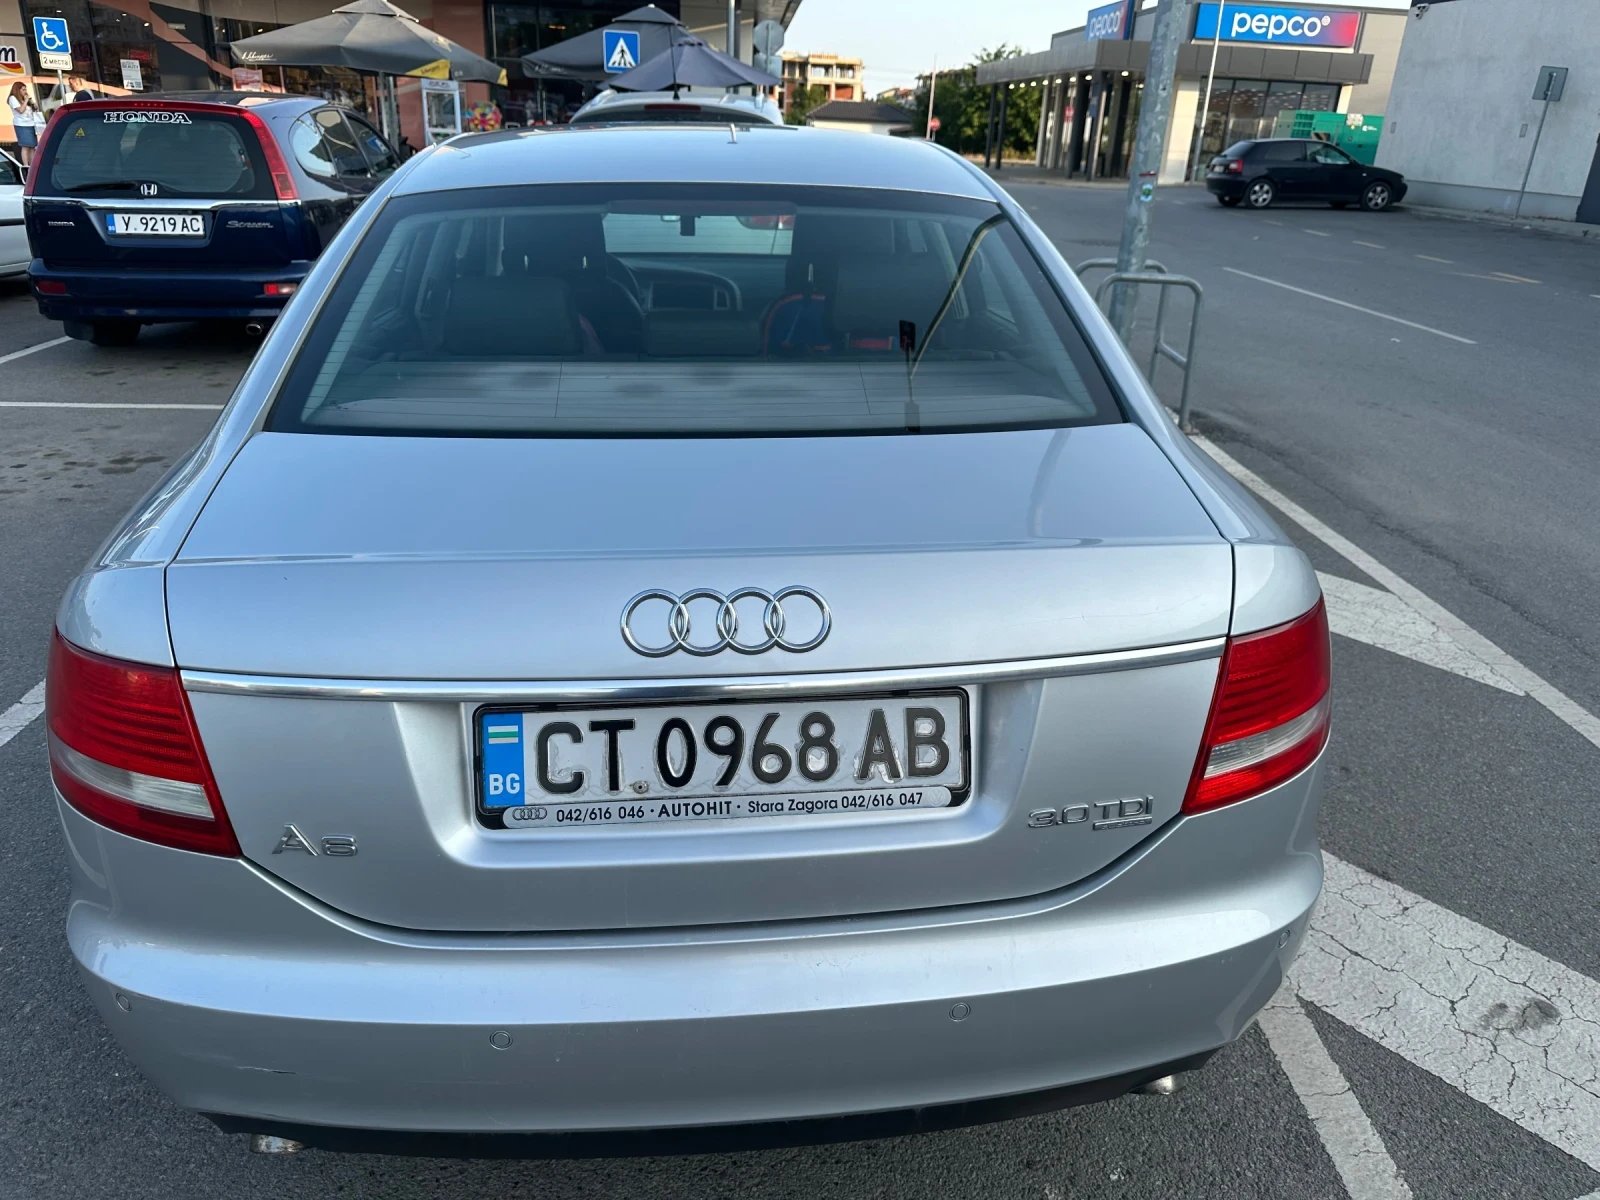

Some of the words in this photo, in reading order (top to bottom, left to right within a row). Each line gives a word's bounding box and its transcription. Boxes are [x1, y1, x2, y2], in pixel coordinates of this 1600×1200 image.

[103, 111, 192, 124] HONDA
[139, 216, 177, 232] 9219
[181, 217, 201, 232] AC
[537, 718, 636, 795] CT
[656, 711, 839, 788] 0968
[857, 707, 950, 780] AB
[489, 773, 521, 796] BG
[556, 806, 612, 823] 042/616
[618, 805, 645, 819] 046
[658, 800, 732, 818] AUTOHIT
[748, 799, 784, 814] Stara
[788, 797, 838, 814] Zagora
[841, 793, 894, 809] 042/616
[899, 792, 923, 806] 047
[1028, 802, 1090, 828] 3.0
[1094, 794, 1154, 820] TDI
[271, 822, 358, 857] A6
